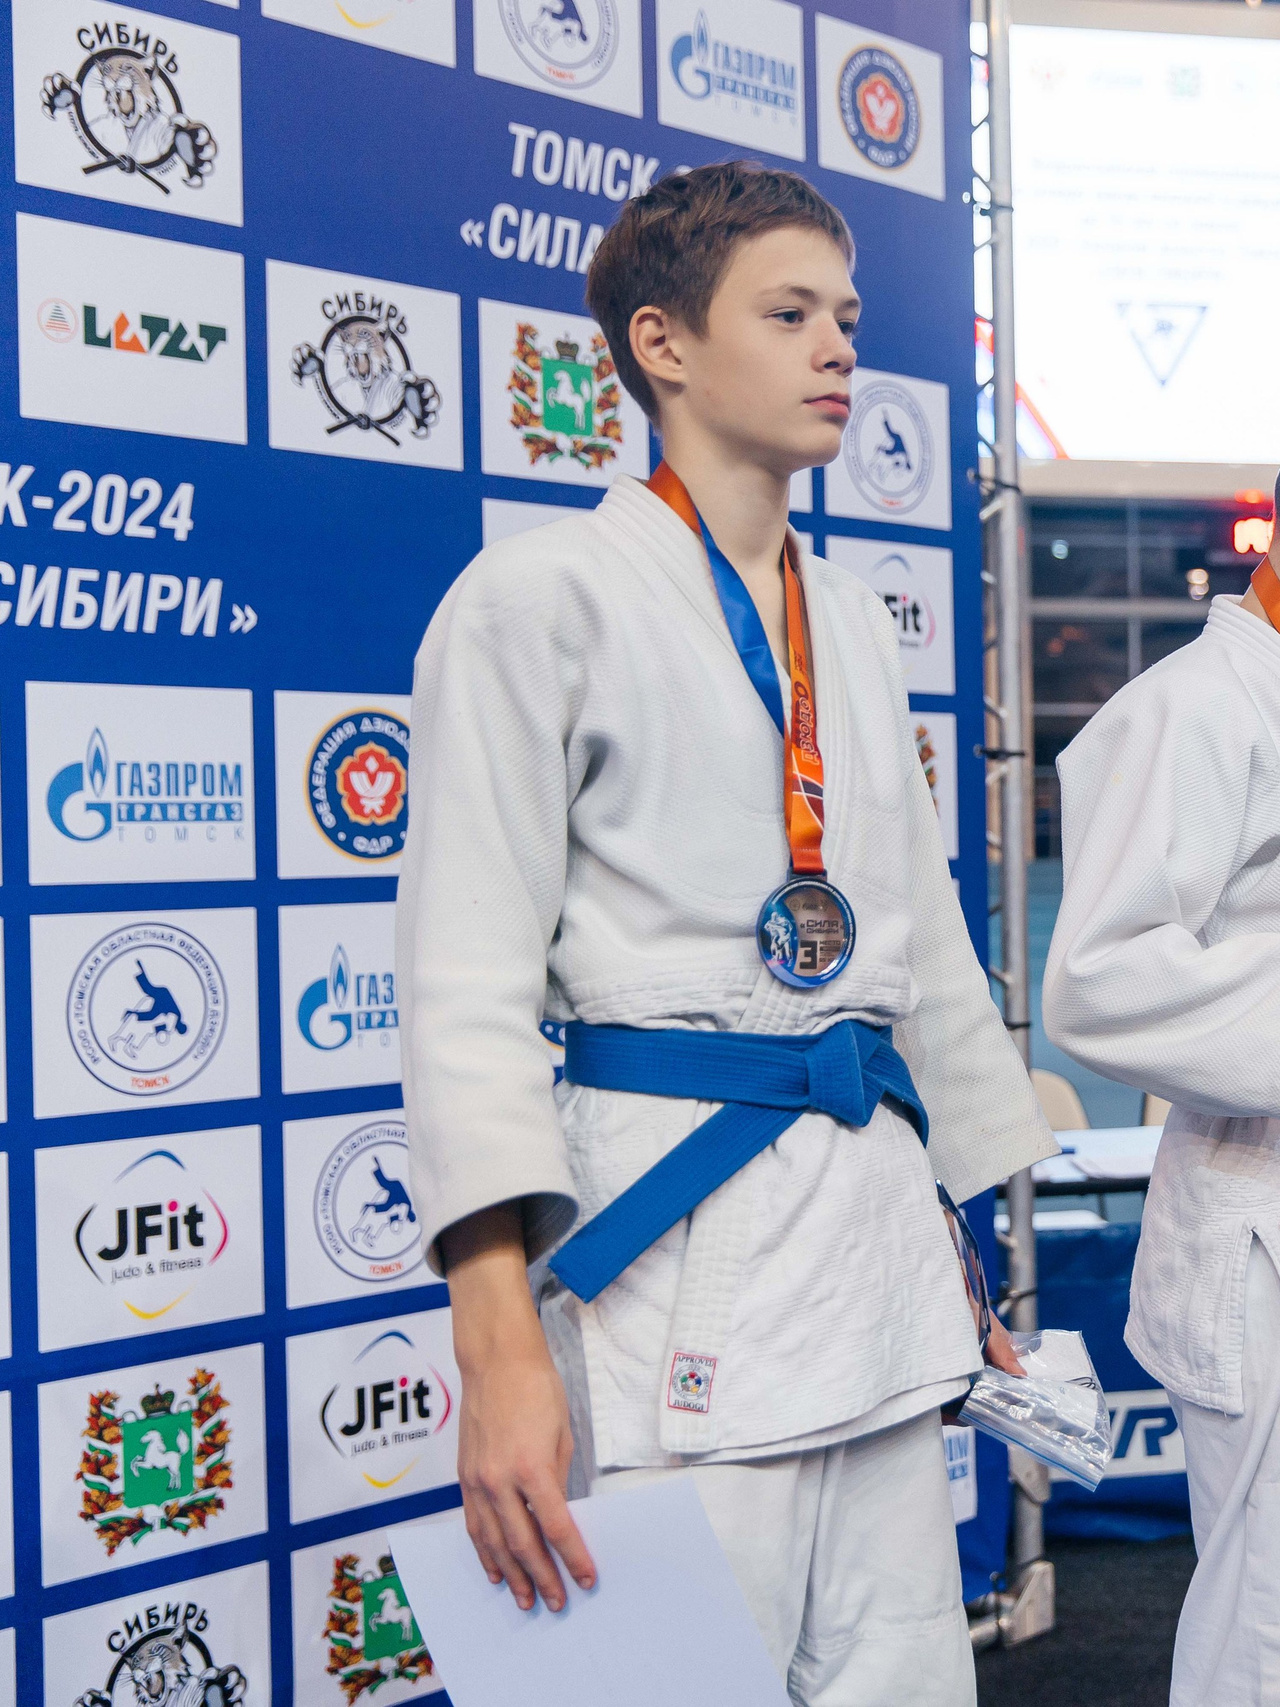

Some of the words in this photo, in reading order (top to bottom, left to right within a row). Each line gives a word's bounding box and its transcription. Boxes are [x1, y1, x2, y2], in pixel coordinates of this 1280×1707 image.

[76, 20, 179, 74] СИБИРЬ
[507, 121, 662, 203] ТОМСК
[321, 292, 408, 335] СИБИРЬ
[884, 593, 921, 633] Fit
[116, 762, 242, 796] ГАЗПРОМ
[118, 803, 242, 822] ТРАНСГАЗ
[116, 825, 245, 842] ТОМСК
[799, 939, 818, 970] 3
[97, 1200, 205, 1262] JFit
[111, 1265, 141, 1284] judo
[145, 1263, 155, 1275] &
[159, 1256, 204, 1274] fitness
[675, 1355, 715, 1367] APPROVED
[340, 1376, 431, 1437] JFit
[673, 1399, 704, 1411] JUDOGI
[106, 1601, 210, 1654] СИБИРЬ
